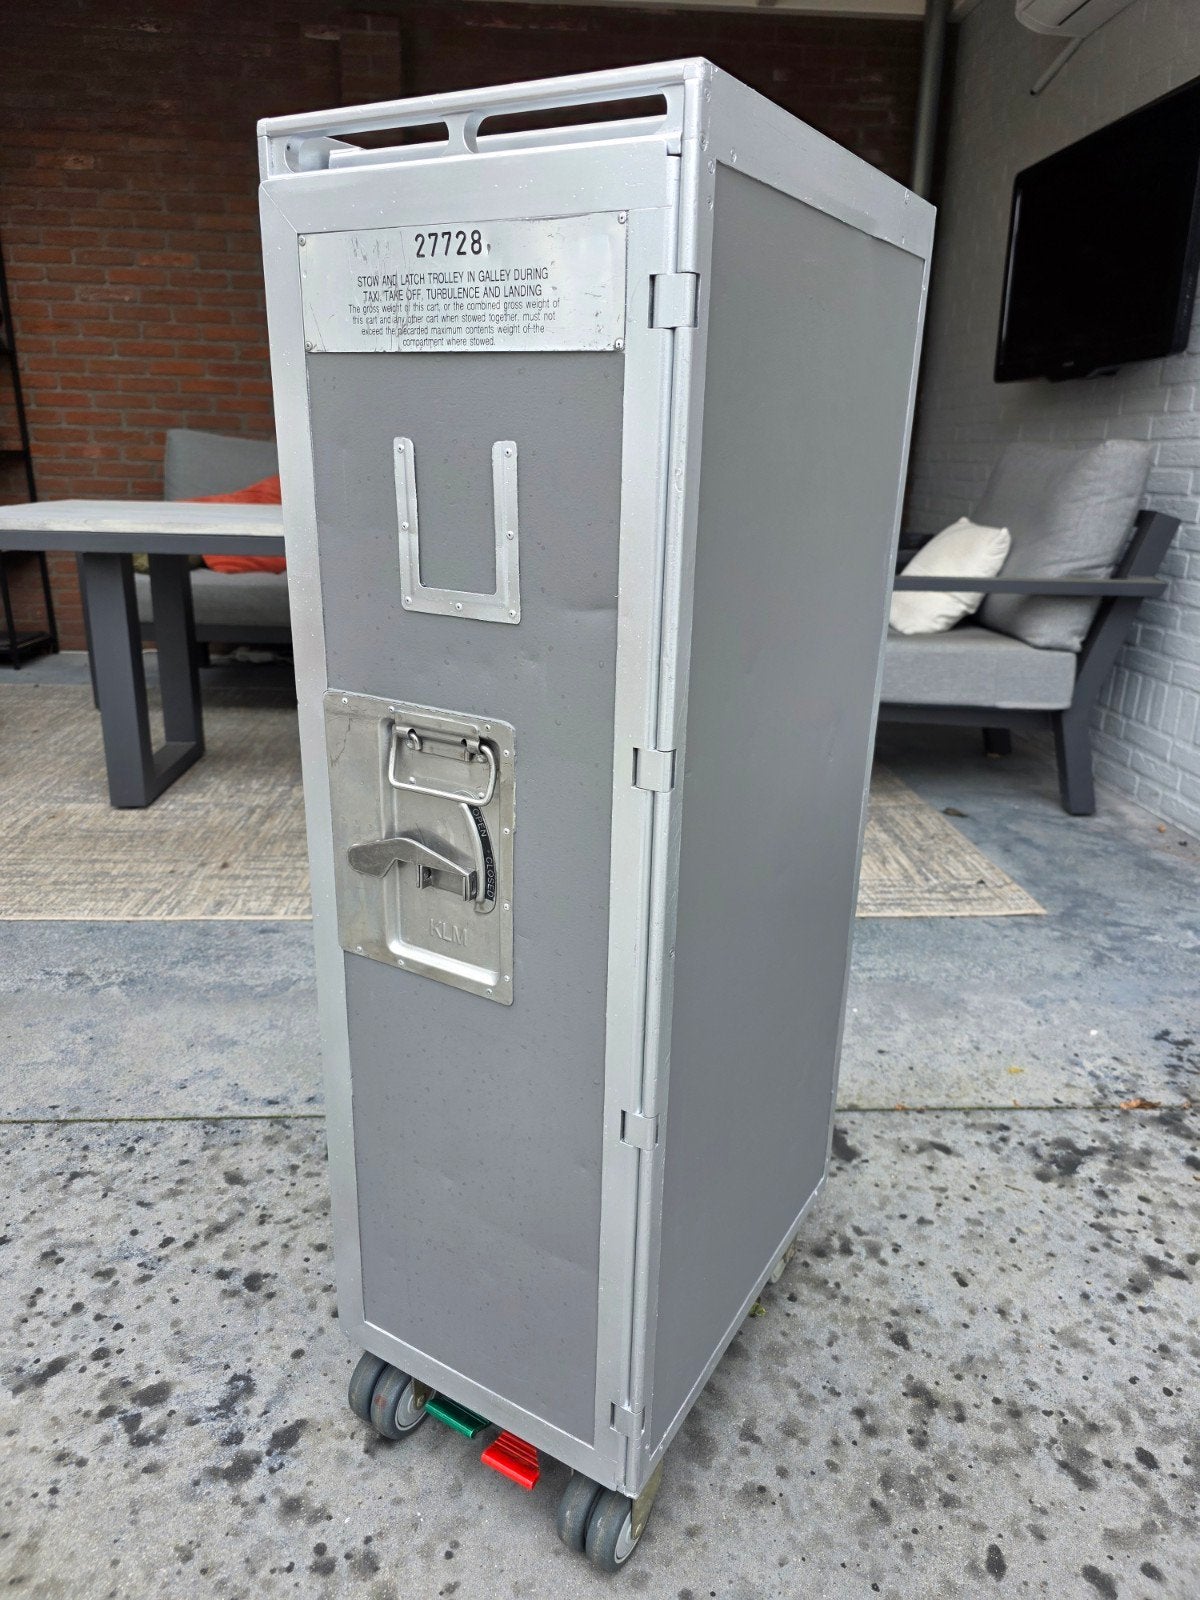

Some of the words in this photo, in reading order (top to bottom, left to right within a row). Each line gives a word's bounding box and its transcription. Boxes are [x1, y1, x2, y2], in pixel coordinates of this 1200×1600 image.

[357, 275, 379, 288] STOW
[382, 273, 398, 287] AND
[400, 273, 425, 286] LATCH
[427, 271, 464, 285] TROLLEY
[467, 270, 476, 283] IN
[478, 269, 511, 282] GALLEY
[513, 267, 549, 281] DURING
[384, 289, 404, 302] TAKE
[426, 286, 480, 300] TURBULENCE
[483, 286, 501, 299] AND
[503, 284, 542, 298] LANDING
[348, 303, 361, 315] The
[362, 304, 380, 316] gross
[382, 301, 402, 315] weight
[412, 301, 424, 313] this
[443, 302, 451, 312] or
[453, 300, 465, 312] the
[466, 299, 501, 311] combined
[503, 301, 524, 312] gross
[525, 298, 550, 311] weight
[552, 297, 560, 309] of
[352, 315, 364, 326] this
[379, 315, 392, 325] and
[425, 314, 439, 324] cart
[441, 313, 461, 324] when
[461, 312, 486, 324] stowed
[522, 311, 541, 322] must
[543, 310, 556, 321] not
[385, 326, 396, 336] the
[430, 325, 463, 336] maximum
[465, 324, 495, 335] contents
[497, 322, 521, 336] weight
[522, 322, 531, 334] of
[533, 322, 545, 334] the
[446, 336, 468, 347] where
[472, 808, 487, 837] OPEN
[485, 856, 495, 898] CLOSED
[430, 917, 469, 947] KLM
